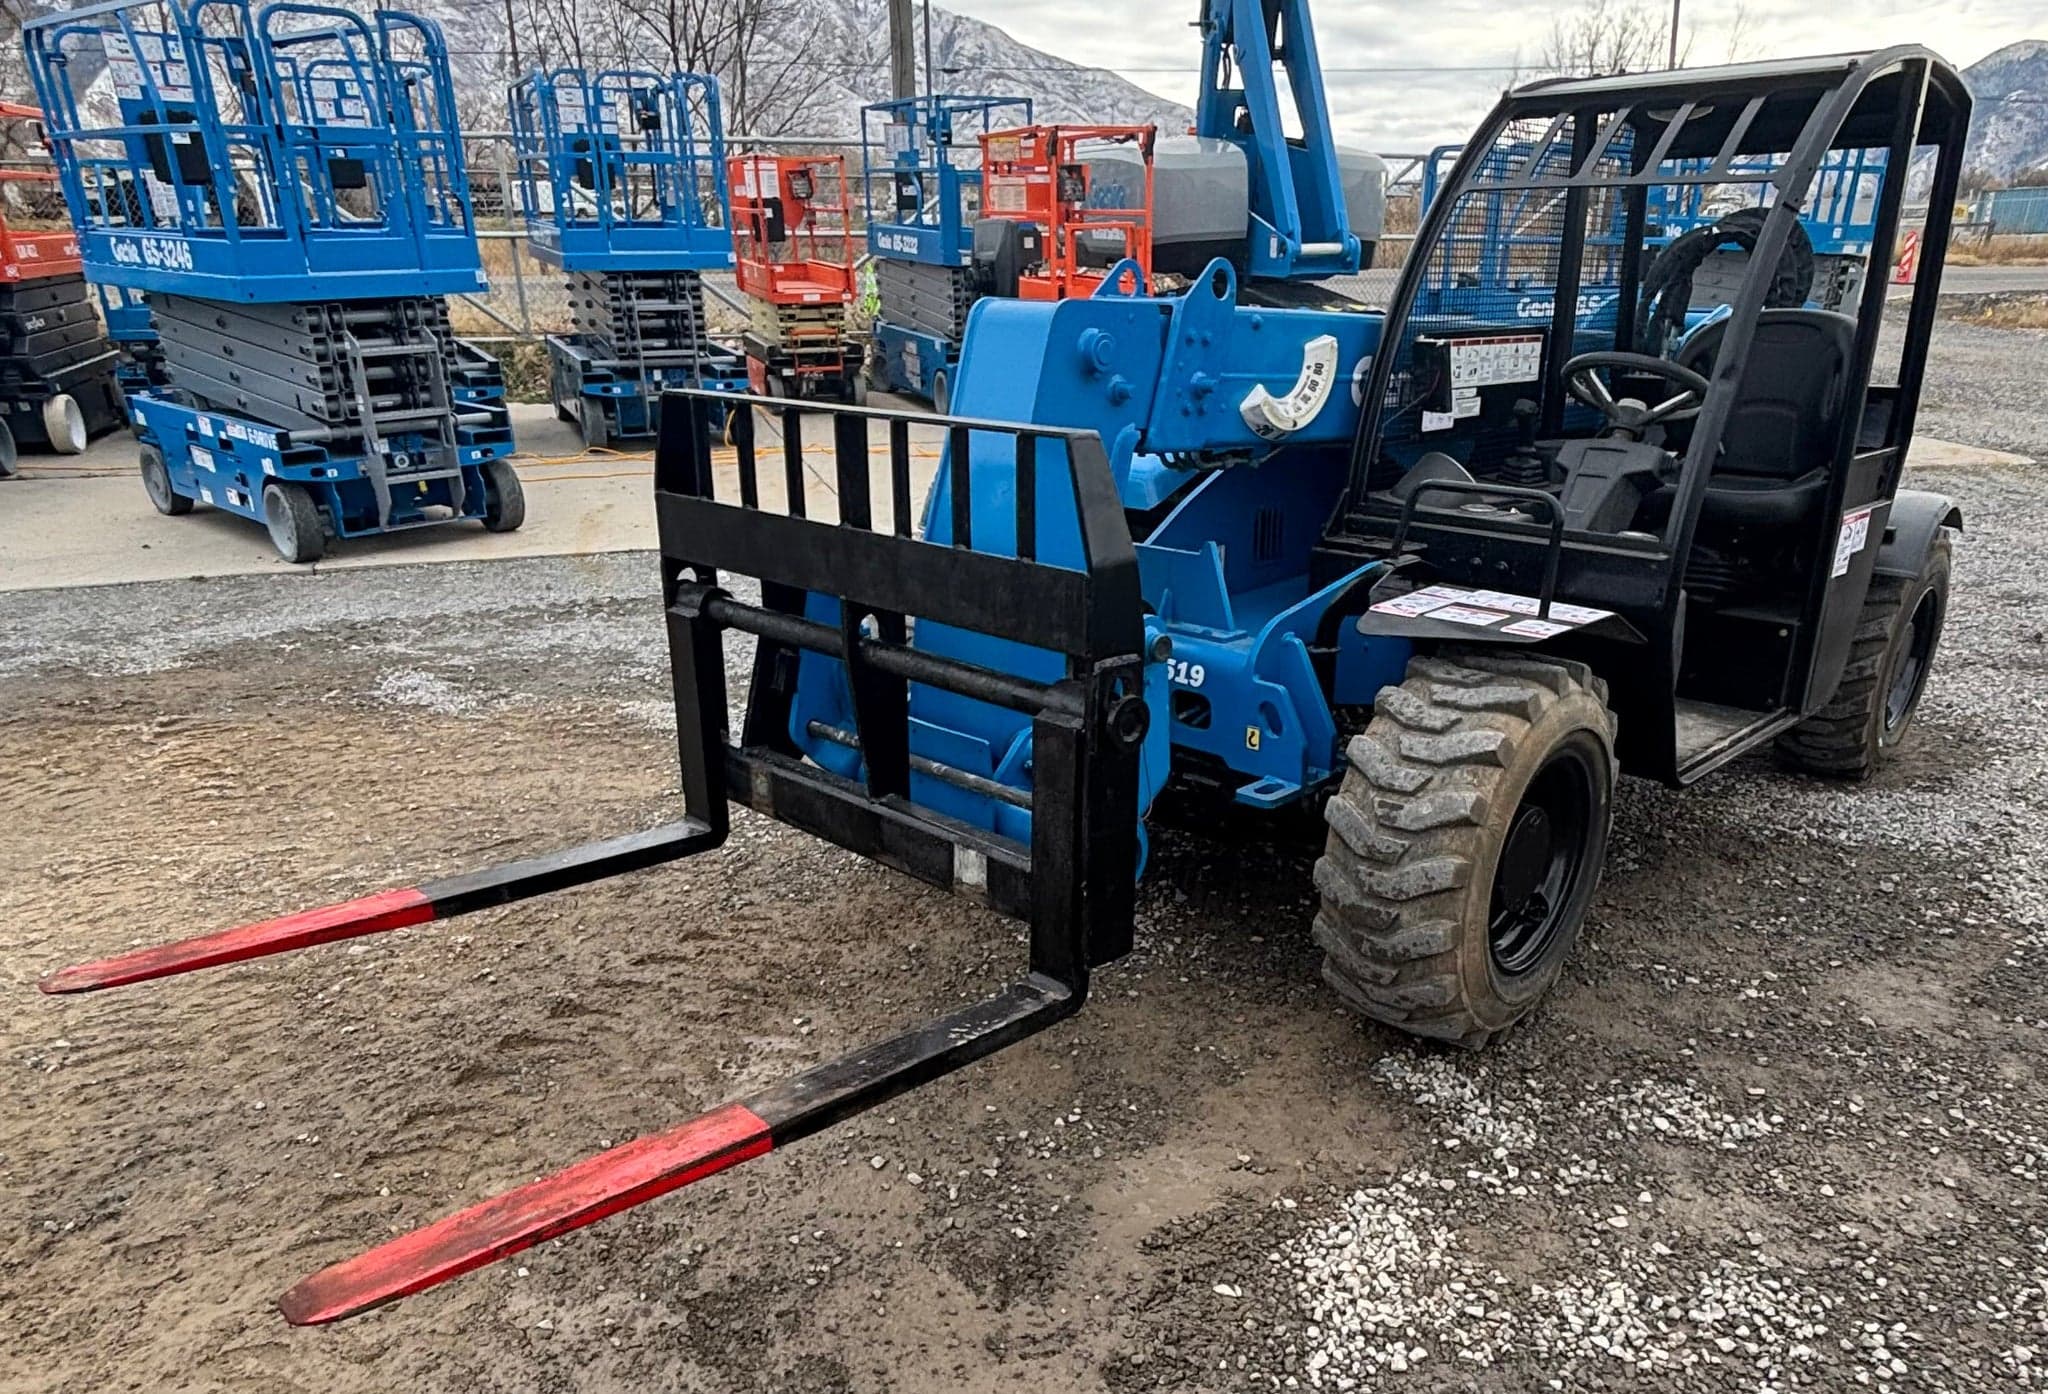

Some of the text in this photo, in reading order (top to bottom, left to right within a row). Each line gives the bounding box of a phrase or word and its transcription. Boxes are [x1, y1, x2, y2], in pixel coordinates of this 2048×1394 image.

[110, 236, 142, 264] Genie
[142, 238, 193, 270] GS-3246
[1517, 297, 1555, 317] Geni
